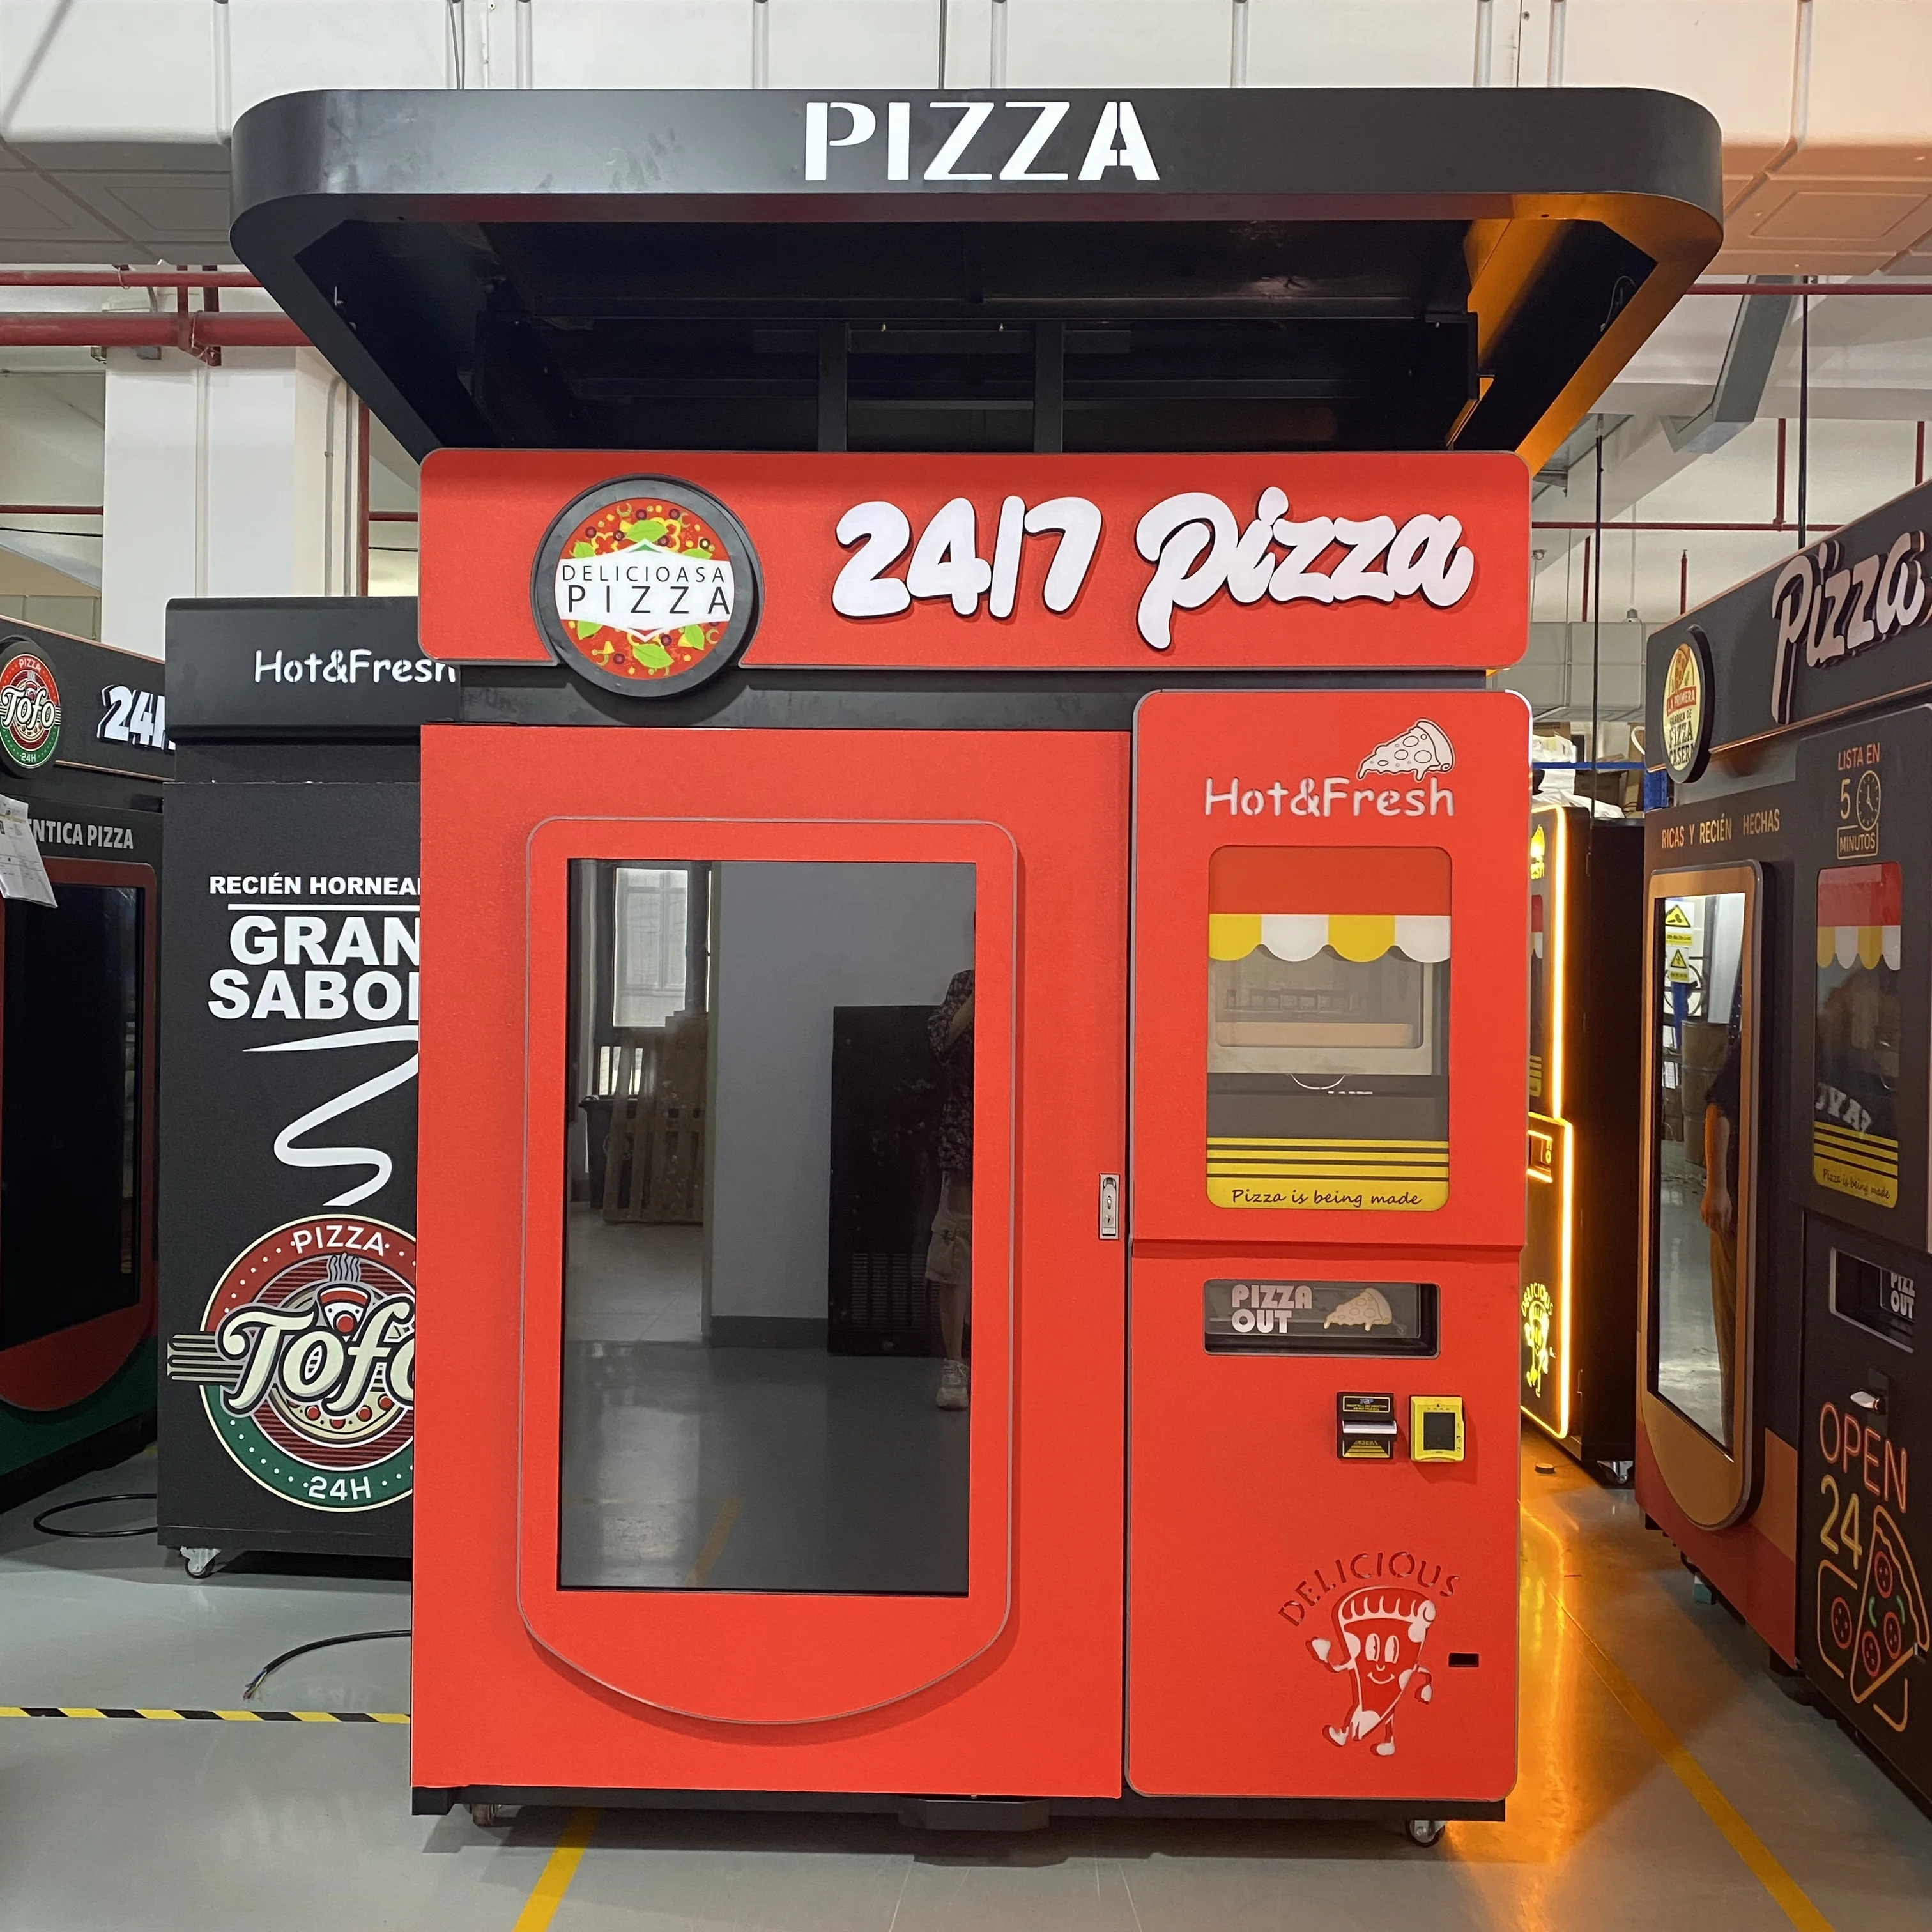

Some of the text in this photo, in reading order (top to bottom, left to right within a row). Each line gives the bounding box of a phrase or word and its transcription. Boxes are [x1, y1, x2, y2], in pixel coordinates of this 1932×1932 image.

[805, 101, 1160, 181] PIZZA
[832, 495, 1102, 618] 24/7
[562, 565, 724, 583] DELICIOASA
[567, 585, 730, 615] PIZZA
[18, 658, 42, 672] PIZZA
[1, 686, 56, 730] Tofo
[1667, 698, 1673, 712] LA
[1669, 720, 1693, 749] PIZZA
[20, 752, 36, 762] 24H
[1837, 742, 1880, 770] LISTA EN
[1204, 776, 1454, 817] Hot&Fresh
[1840, 778, 1851, 820] 5
[27, 818, 134, 850] NTICA PIZZA
[1661, 808, 1781, 849] RICAS Y RECIÉN HECHAS
[1839, 832, 1876, 852] MINUTOS
[209, 872, 420, 896] RECIÉN HORNEA
[229, 914, 419, 966] GRAN
[208, 969, 419, 1022] SABO
[1232, 1188, 1423, 1208] Pizza is being made
[1823, 1168, 1890, 1199] Pizza is being made
[293, 1224, 385, 1257] PIZZA
[1231, 1284, 1312, 1309] PIZZA
[1521, 1282, 1554, 1317] DELICIOUS
[1890, 1272, 1915, 1298] PIZZ
[1890, 1290, 1915, 1319] OUT
[1231, 1308, 1292, 1334] OUT
[1820, 1401, 1907, 1514] OPEN
[308, 1476, 372, 1501] 24H
[1820, 1473, 1863, 1570] 24
[1278, 1551, 1460, 1627] DELICIOUS
